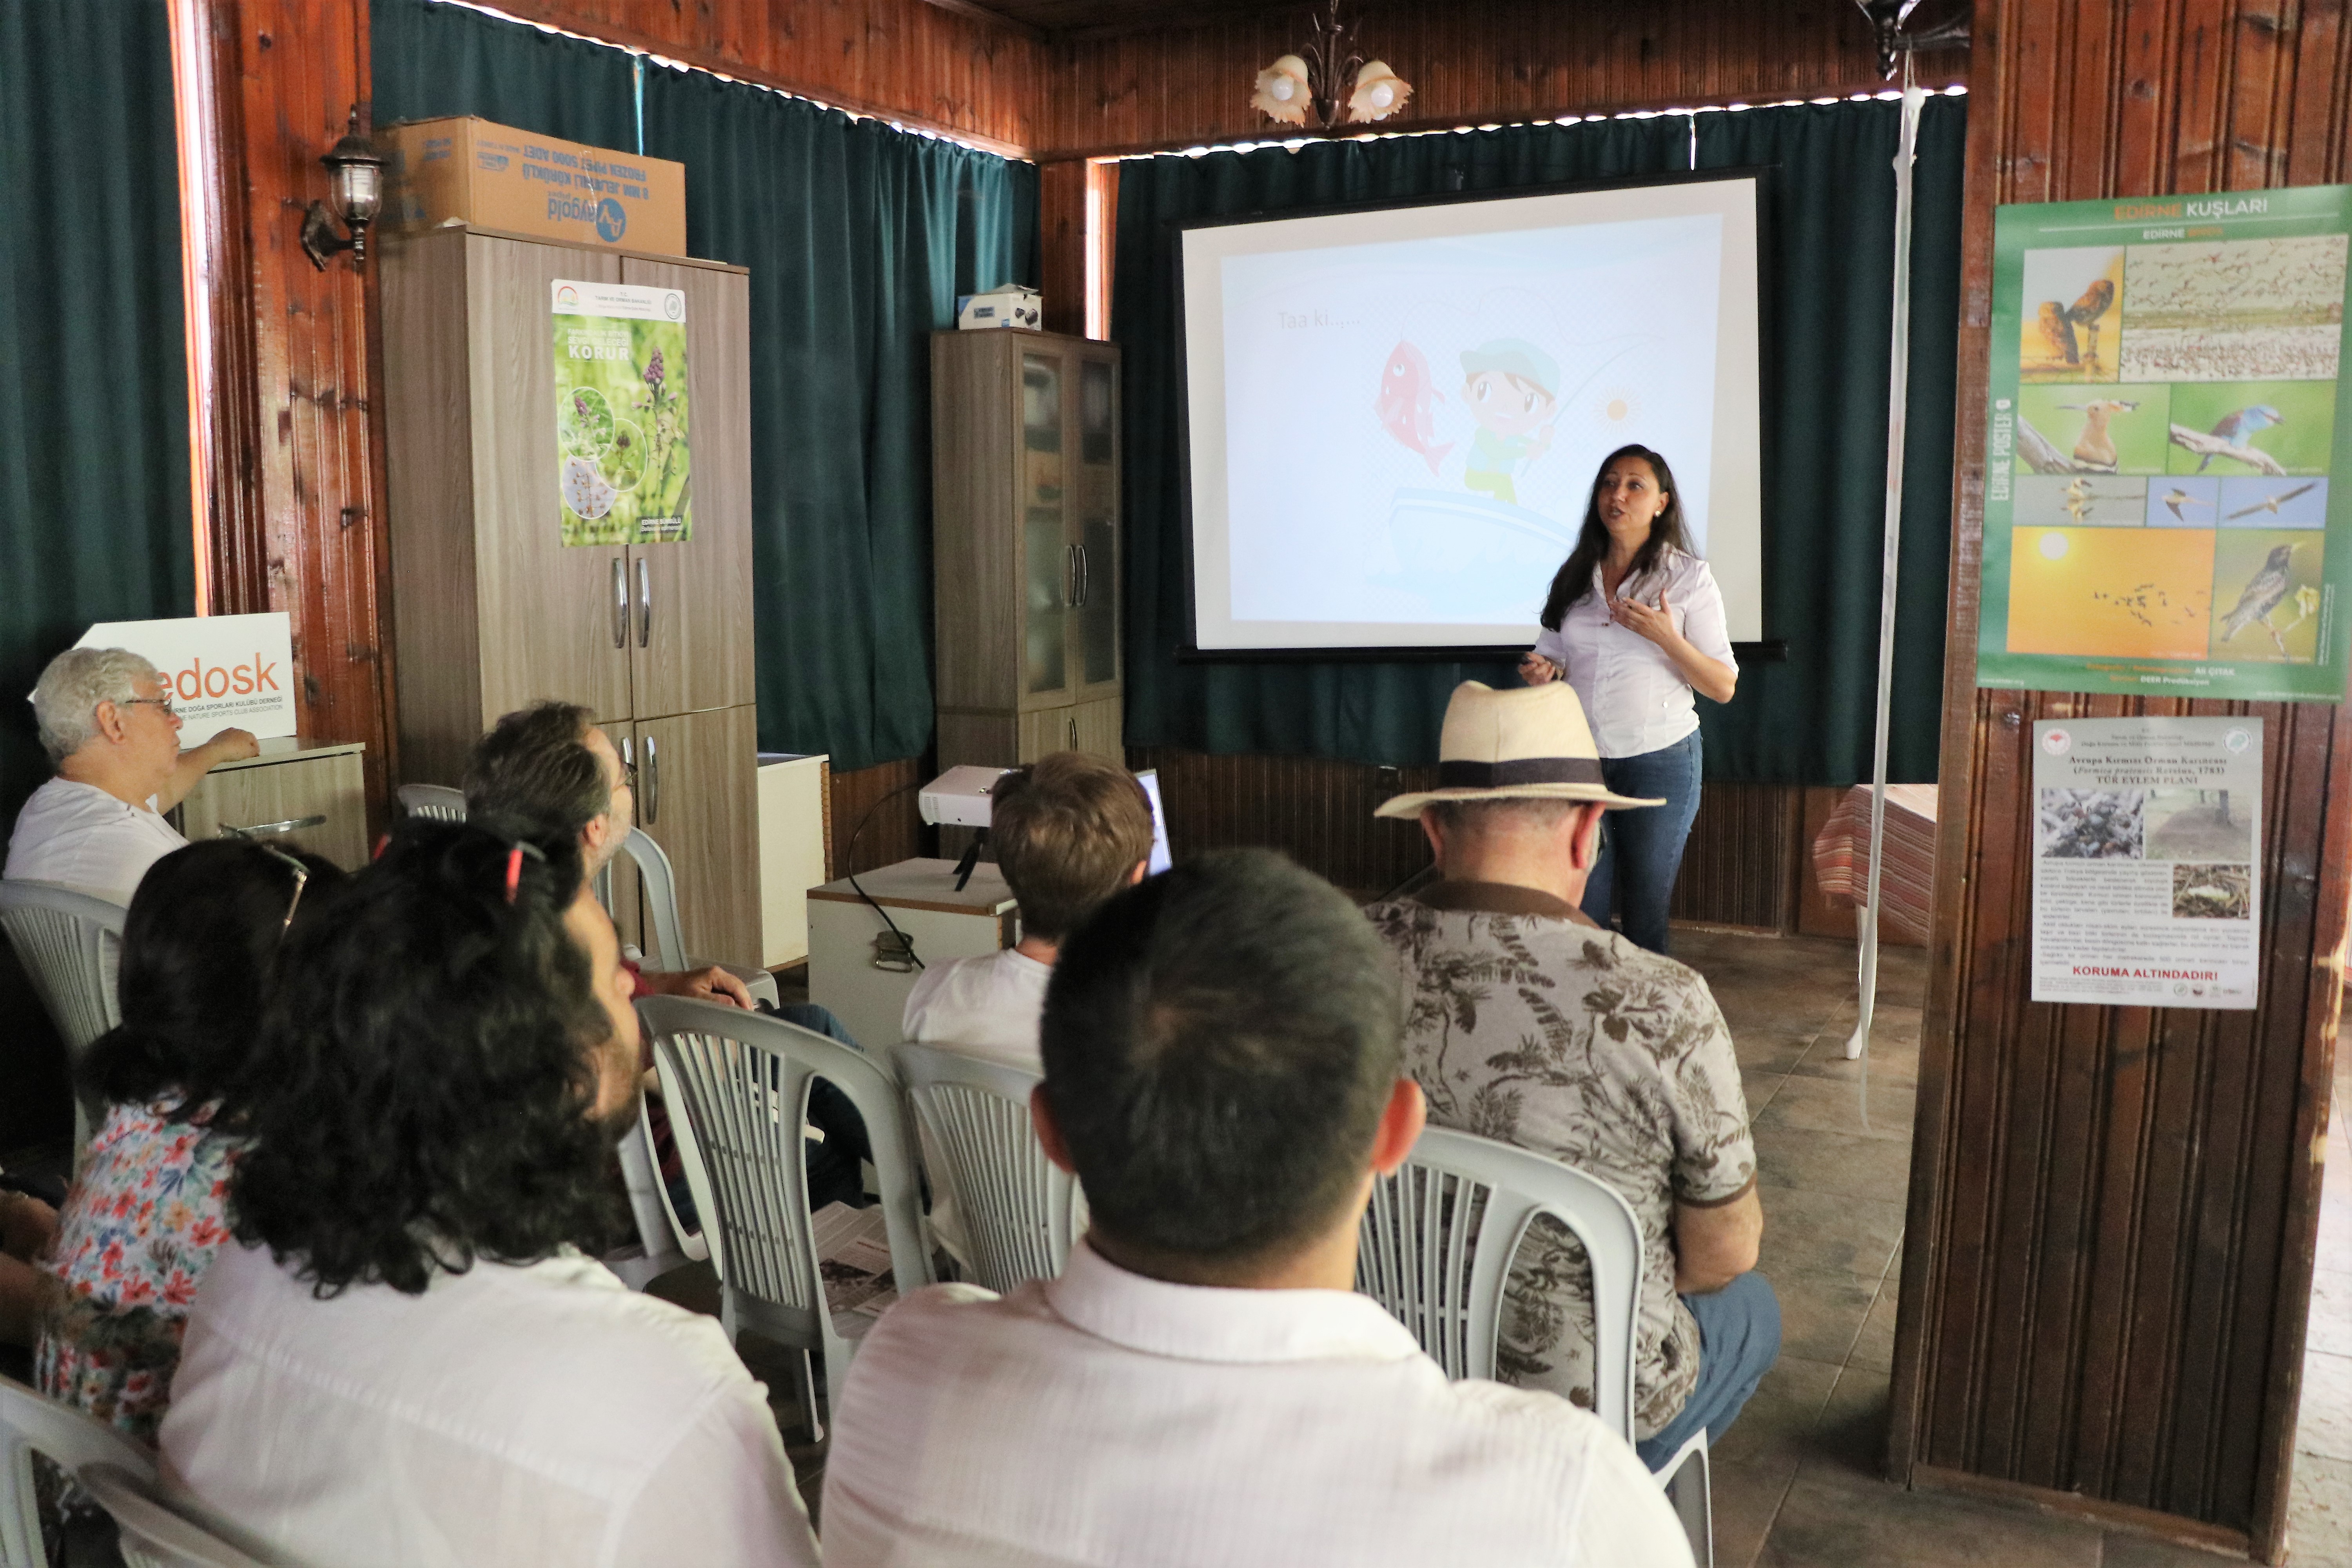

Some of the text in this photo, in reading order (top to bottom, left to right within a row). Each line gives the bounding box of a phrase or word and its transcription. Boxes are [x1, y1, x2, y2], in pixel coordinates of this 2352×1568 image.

[2186, 198, 2268, 219] KUŞLARI
[1277, 312, 1307, 329] Taa
[569, 345, 629, 360] KORUR
[158, 652, 280, 700] edosk
[2070, 756, 2103, 766] Avrupa
[2145, 756, 2178, 765] Orman
[2097, 775, 2118, 784] TÜR
[2073, 966, 2129, 977] KORUMA
